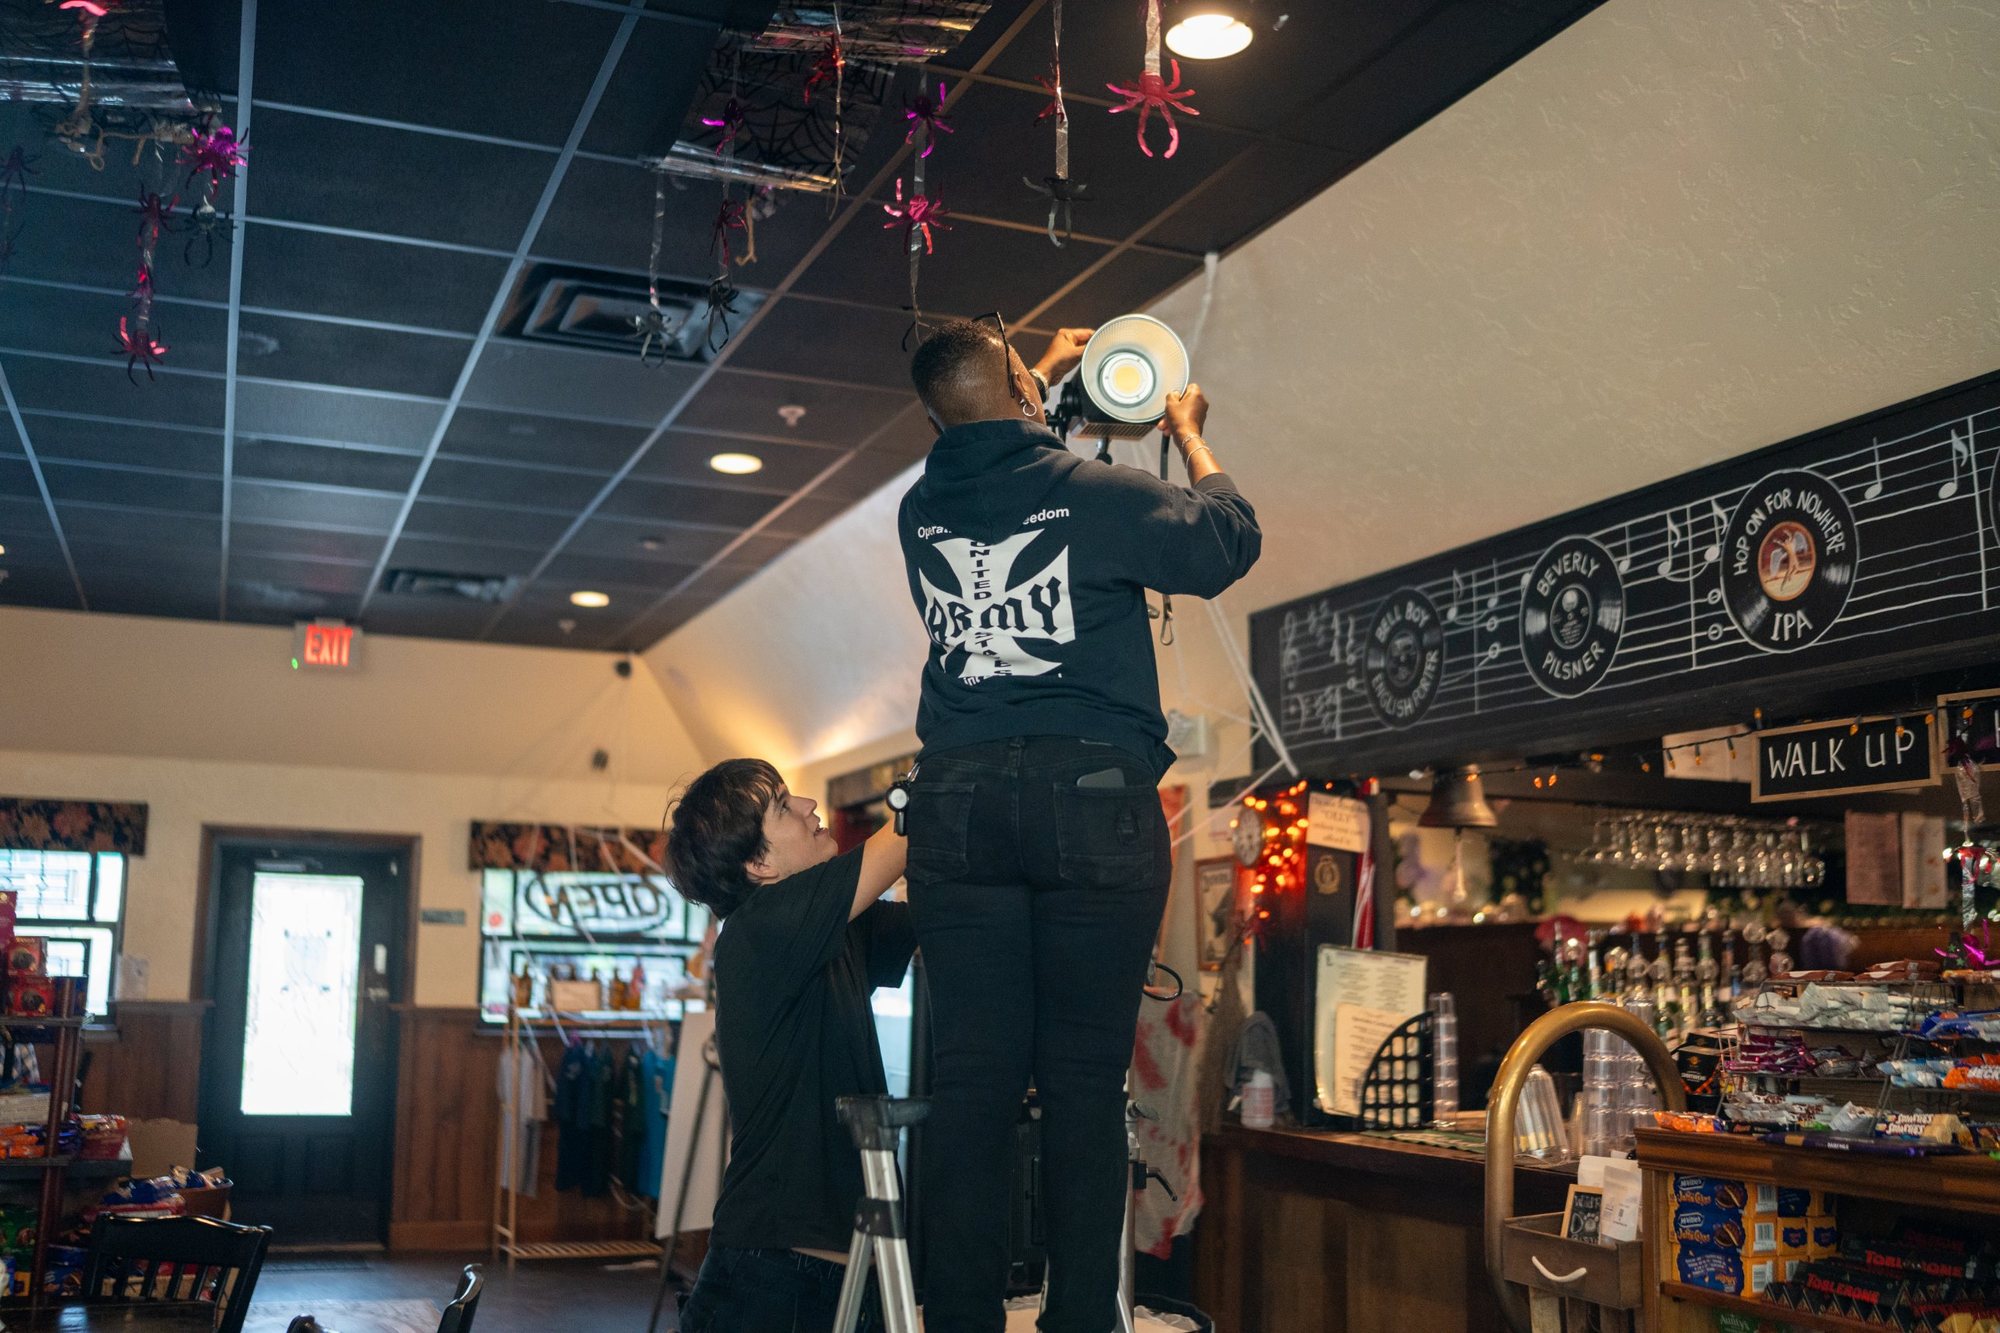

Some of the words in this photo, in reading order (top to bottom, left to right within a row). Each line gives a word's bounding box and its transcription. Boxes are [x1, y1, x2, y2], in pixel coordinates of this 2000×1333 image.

[1732, 535, 1750, 576] HOP
[1745, 507, 1767, 536] ON
[1764, 488, 1793, 515] FOR
[1796, 489, 1846, 556] NOWHERE
[1536, 551, 1600, 597] BEVERLY
[1375, 604, 1403, 644] BELL
[1404, 600, 1431, 628] BOY
[1770, 609, 1814, 641] IPA
[304, 624, 353, 667] EXIT
[1542, 640, 1606, 681] PILSNER
[1371, 672, 1416, 718] ENGLISH
[1412, 649, 1440, 708] PORTER
[1768, 737, 1847, 780] WALK
[1864, 729, 1915, 768] UP
